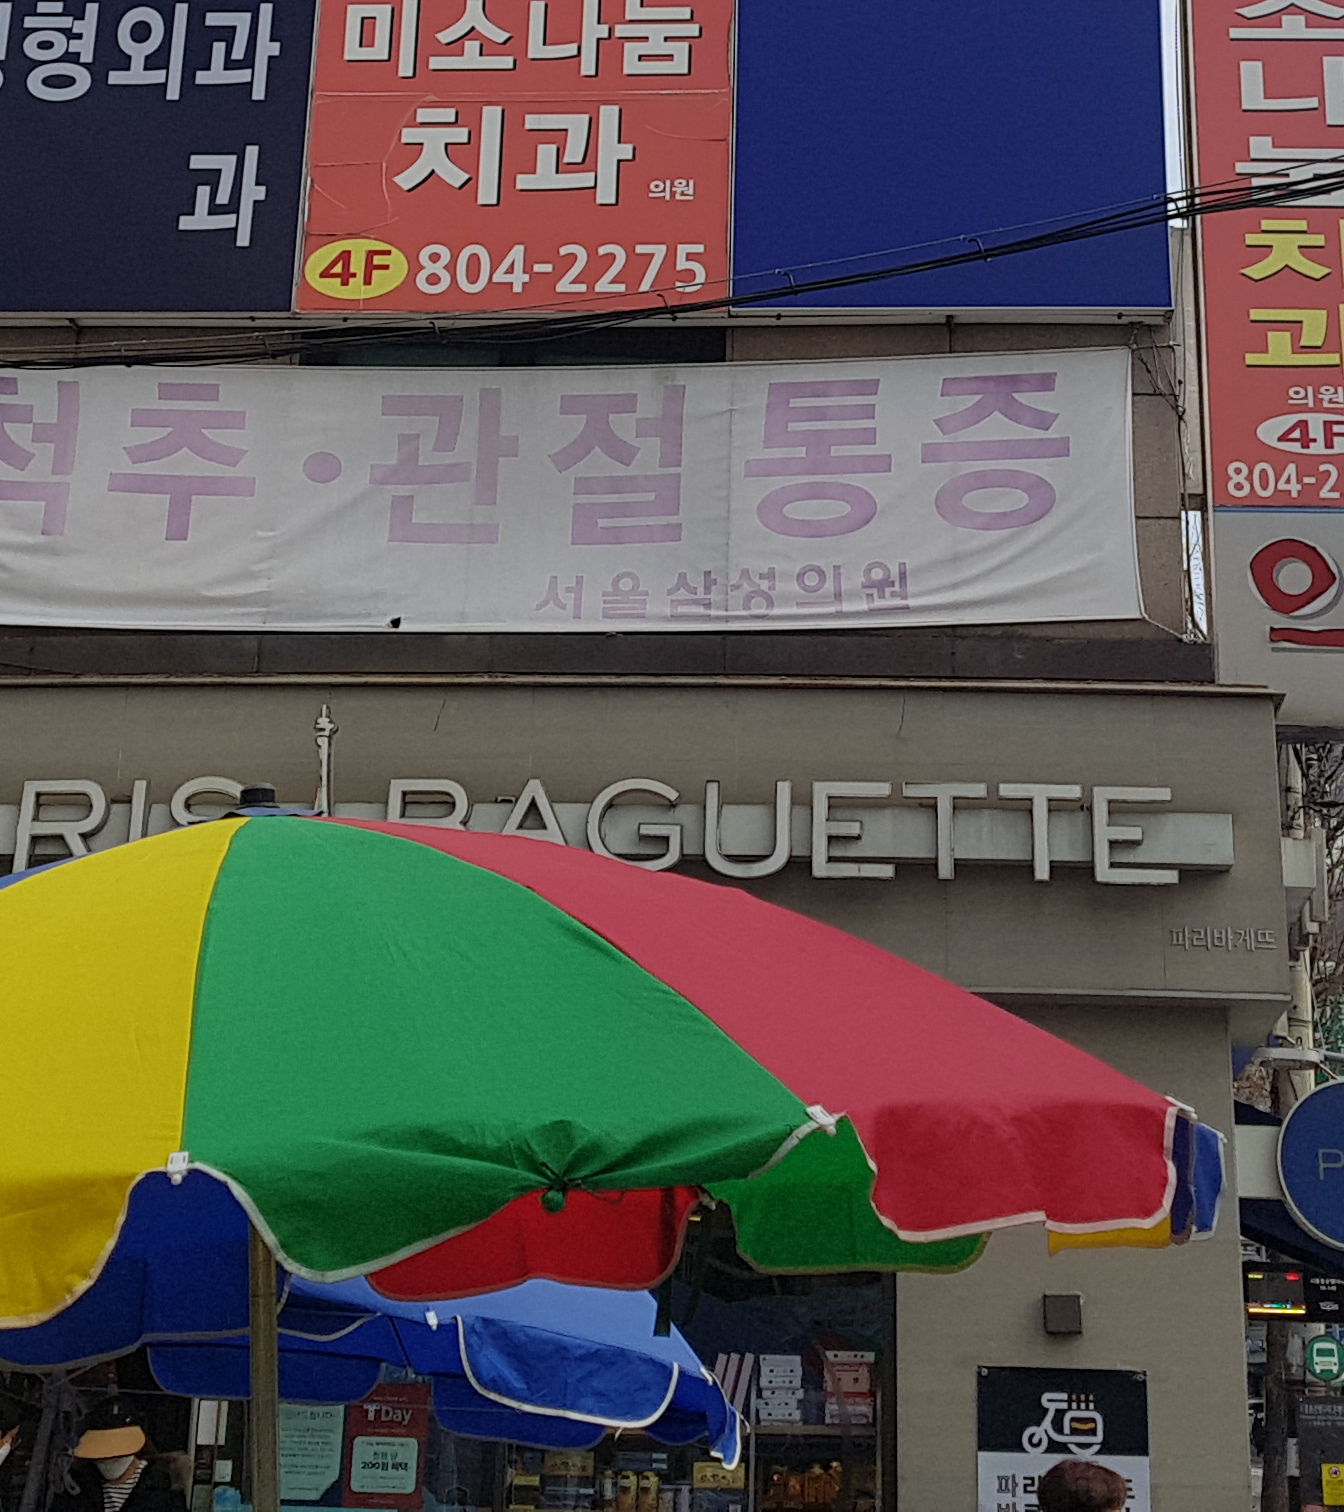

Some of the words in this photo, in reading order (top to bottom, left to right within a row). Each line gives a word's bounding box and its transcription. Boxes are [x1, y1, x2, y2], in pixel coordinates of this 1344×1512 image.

[393, 104, 635, 207] 치과
[648, 178, 695, 201] 의원
[317, 249, 392, 289] 4F
[414, 242, 708, 294] 804-2275
[535, 559, 912, 622] 서울삼성의원
[1169, 925, 1278, 952] 파리바게뜨
[380, 1404, 413, 1426] Day
